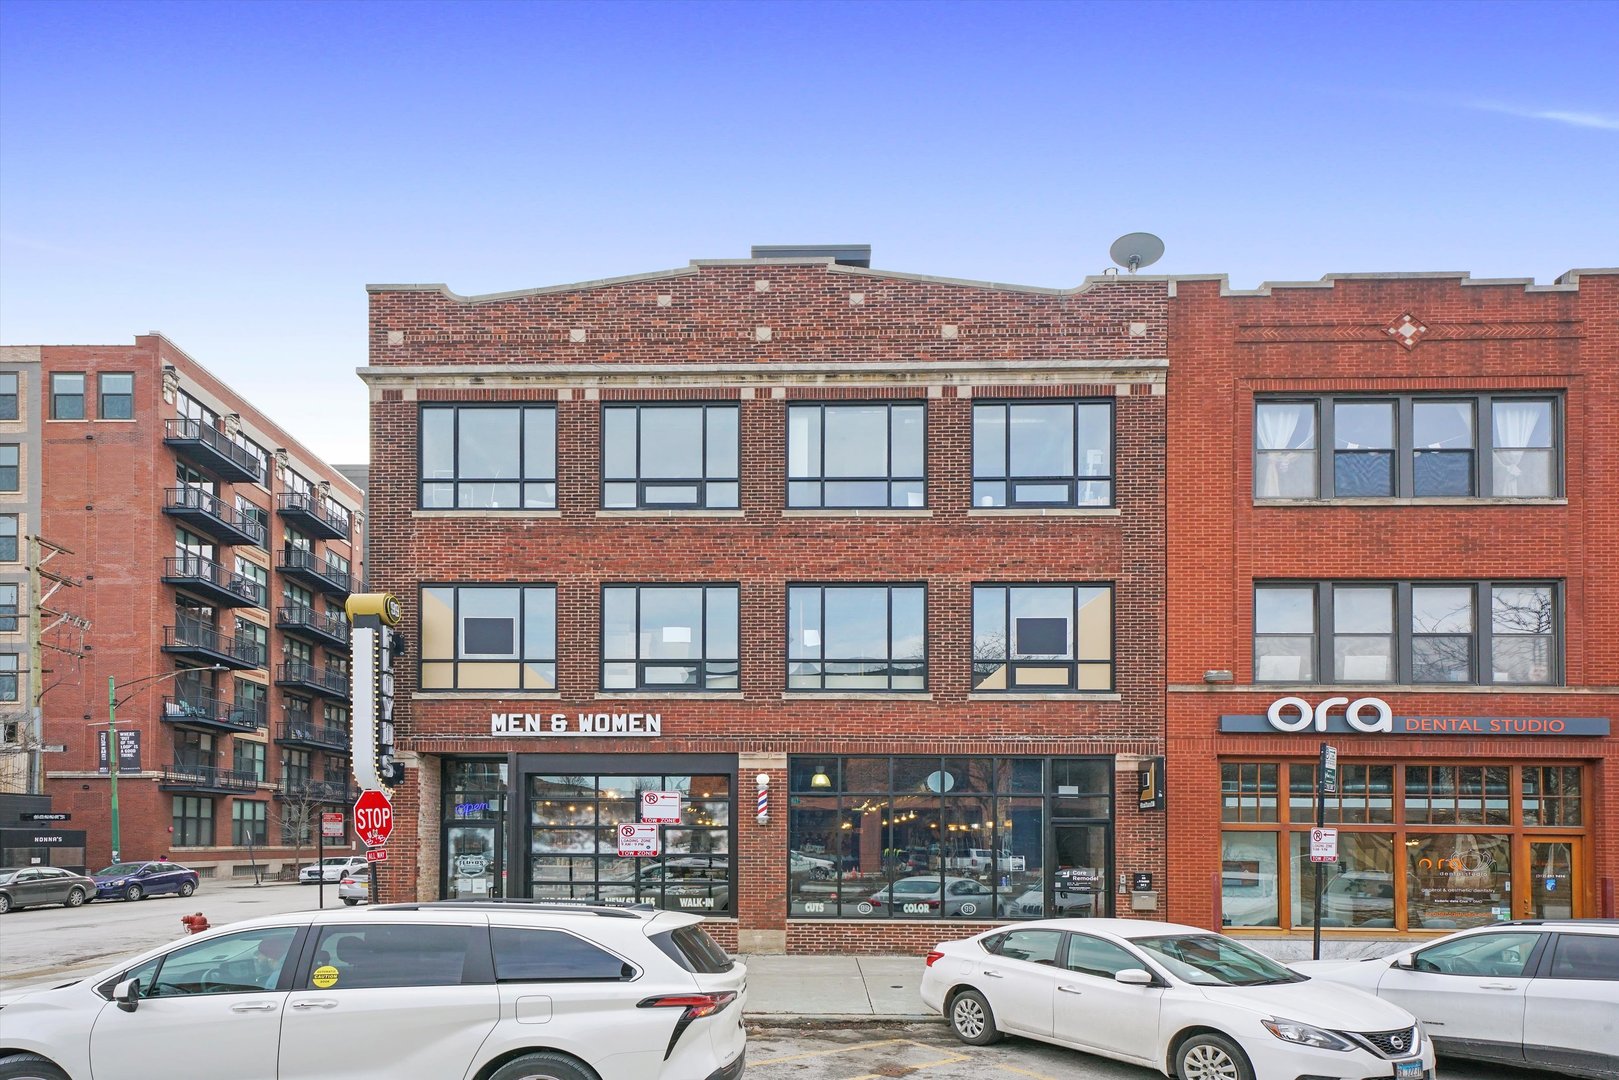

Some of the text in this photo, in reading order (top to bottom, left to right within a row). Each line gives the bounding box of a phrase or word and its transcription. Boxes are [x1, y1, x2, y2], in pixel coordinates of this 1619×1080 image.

[390, 601, 400, 617] 99
[1267, 697, 1393, 732] ora
[491, 713, 661, 732] MEN & WOMEN
[1405, 718, 1565, 733] DENTAL STUDIO
[357, 808, 391, 830] STOP
[368, 852, 377, 860] ALL
[1419, 857, 1463, 870] ora
[805, 902, 825, 913] CUTS
[903, 903, 930, 913] COLOR
